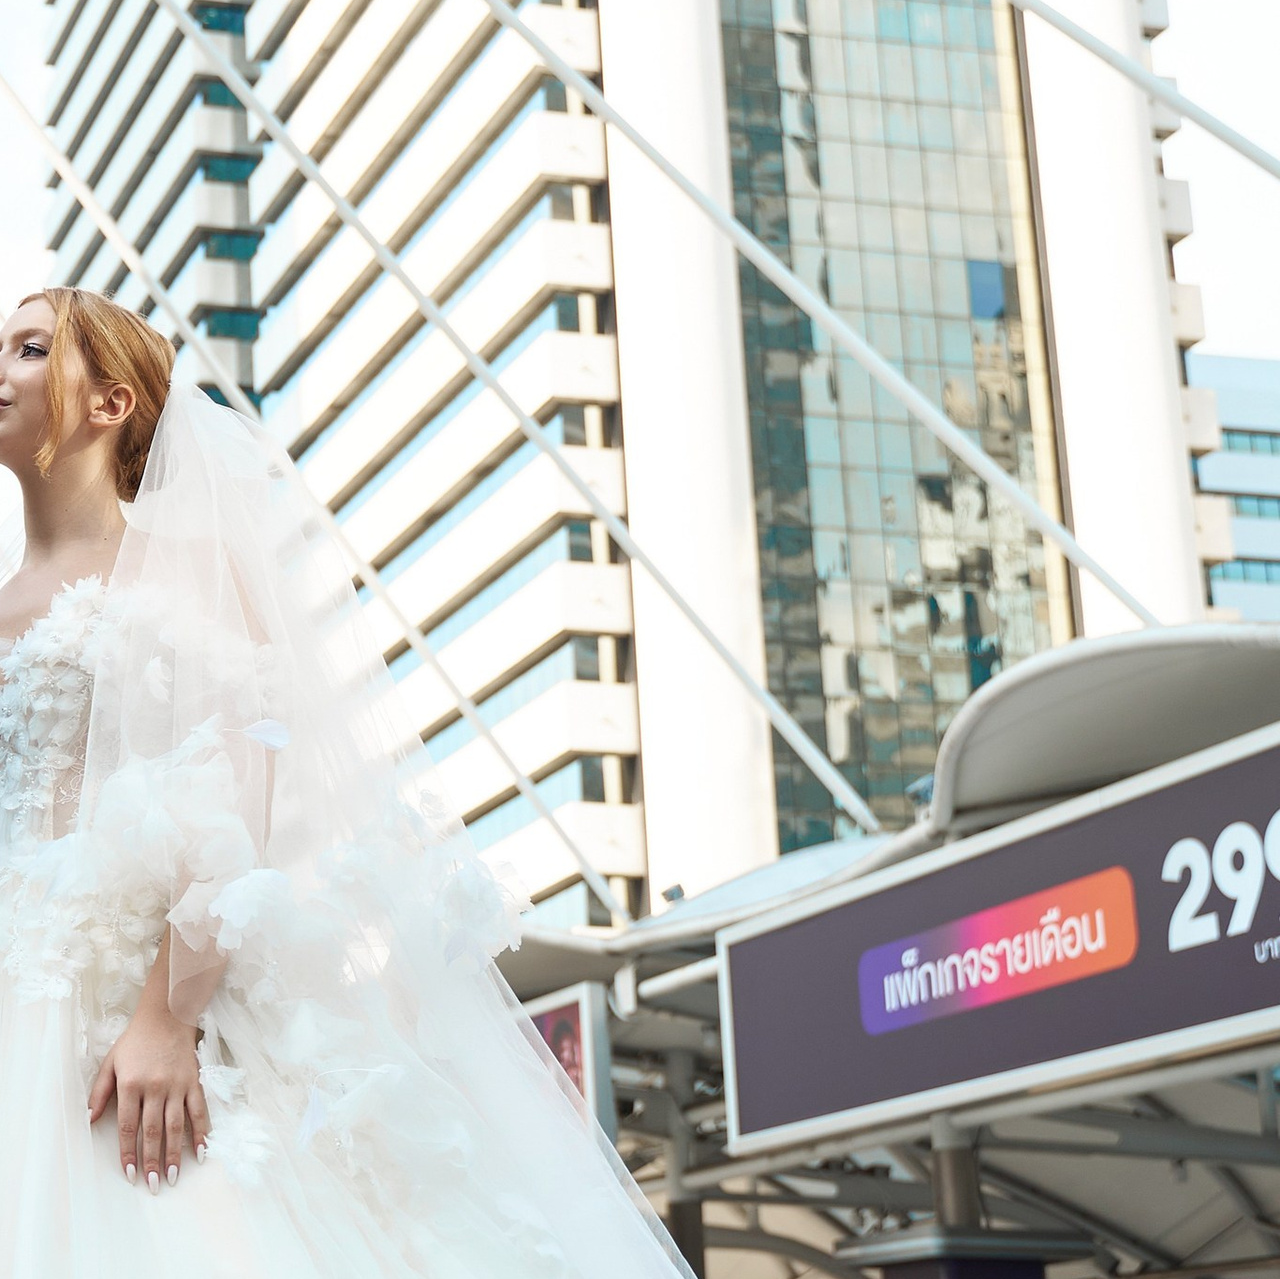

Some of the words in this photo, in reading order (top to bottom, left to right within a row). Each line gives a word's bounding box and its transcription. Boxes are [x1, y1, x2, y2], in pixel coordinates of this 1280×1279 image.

[883, 906, 1106, 1013] แพ็กเกจรายเดือน
